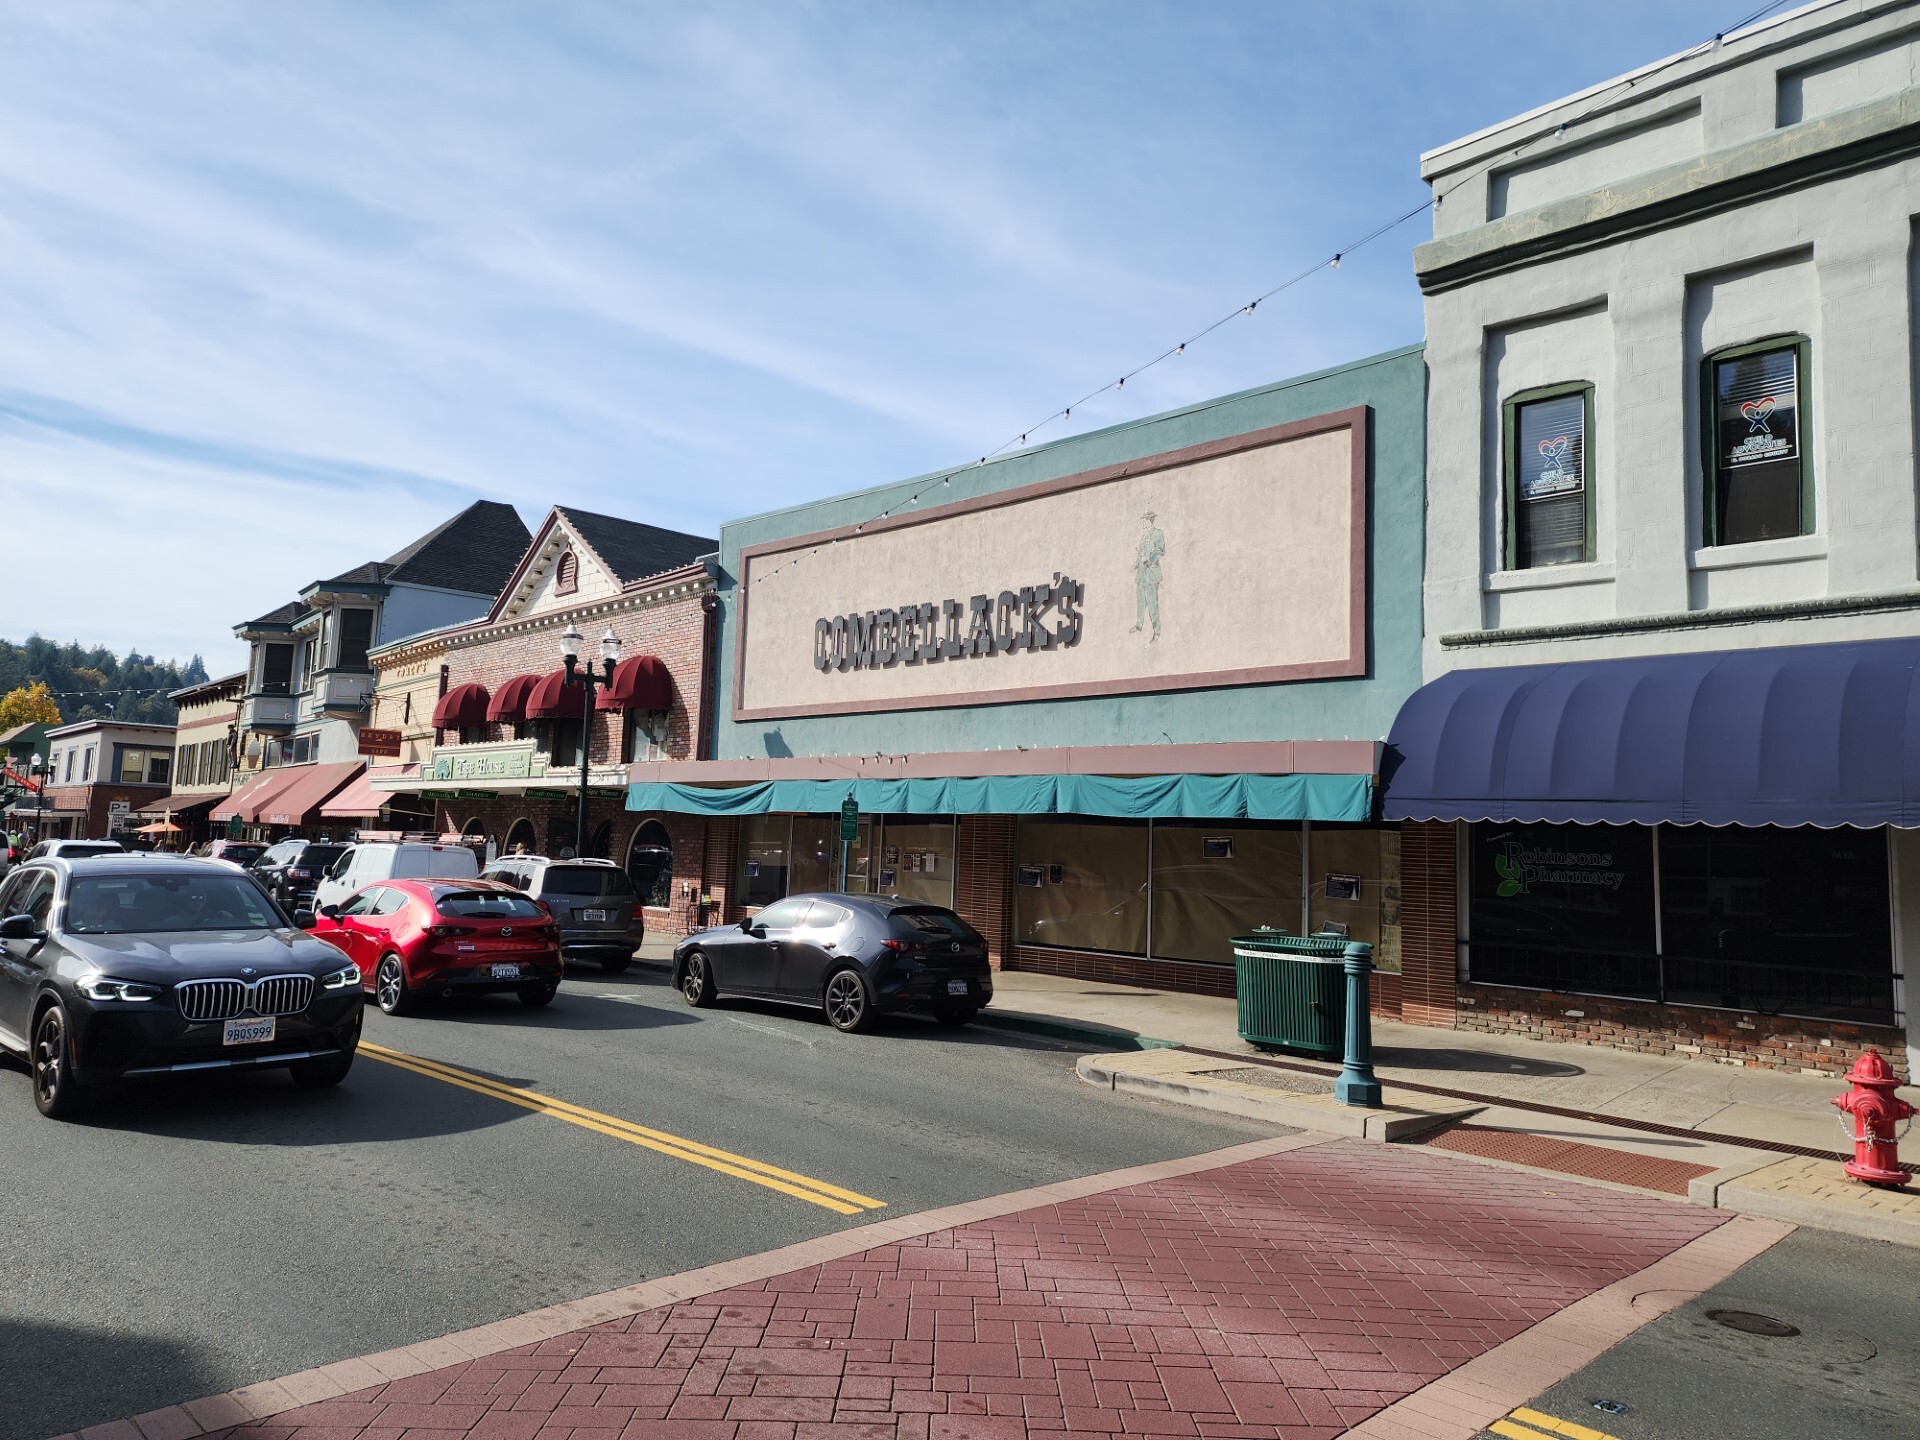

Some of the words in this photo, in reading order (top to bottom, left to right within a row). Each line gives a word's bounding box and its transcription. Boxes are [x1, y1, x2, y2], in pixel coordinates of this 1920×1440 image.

[1731, 438, 1787, 454] ADVOCATES
[1744, 434, 1773, 444] CHILD
[814, 572, 1077, 670] COMBELLACK'S
[1503, 842, 1613, 870] Robinsons
[1520, 865, 1625, 893] Pharmacy
